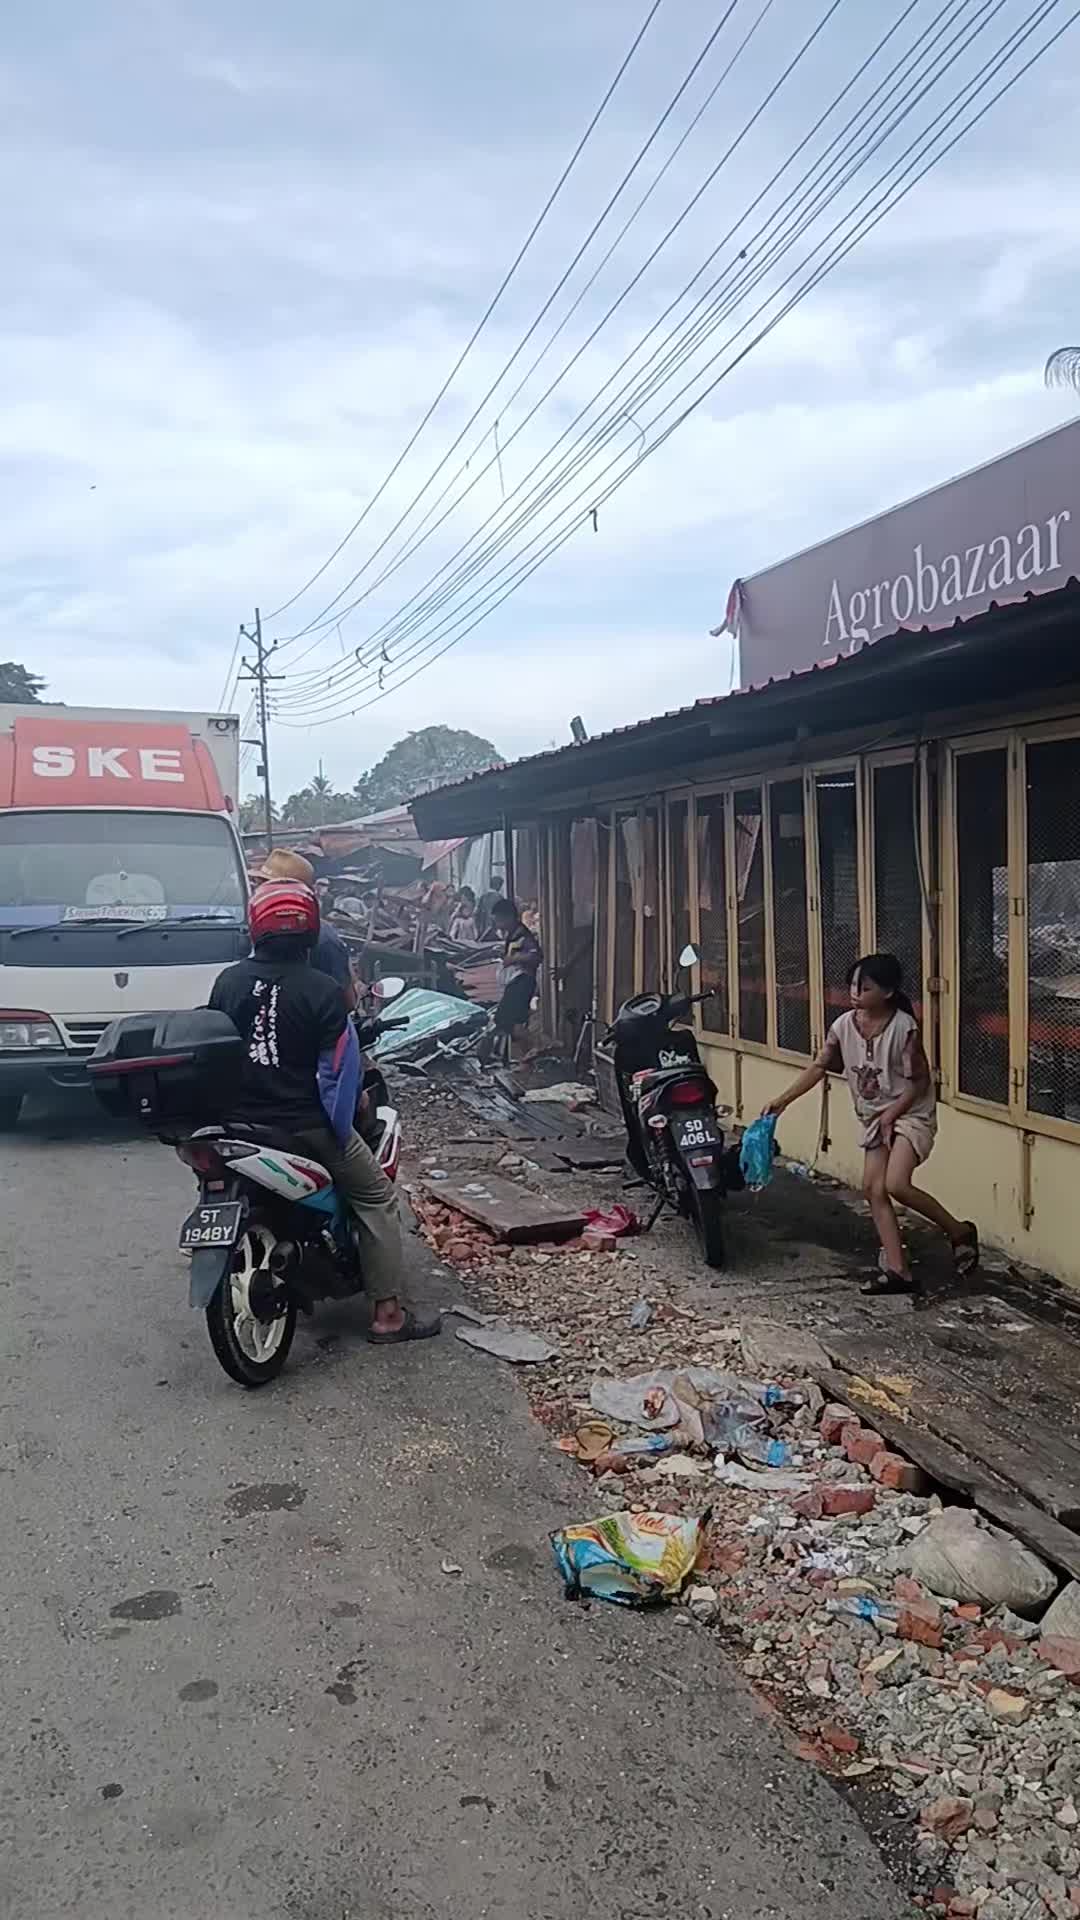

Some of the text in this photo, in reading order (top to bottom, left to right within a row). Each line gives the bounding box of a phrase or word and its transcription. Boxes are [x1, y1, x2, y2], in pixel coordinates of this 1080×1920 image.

[823, 510, 1070, 652] Agrobazaar
[32, 746, 185, 782] SKE
[685, 1119, 703, 1132] SD
[200, 1209, 221, 1223] ST
[185, 1226, 232, 1242] 1948Y
